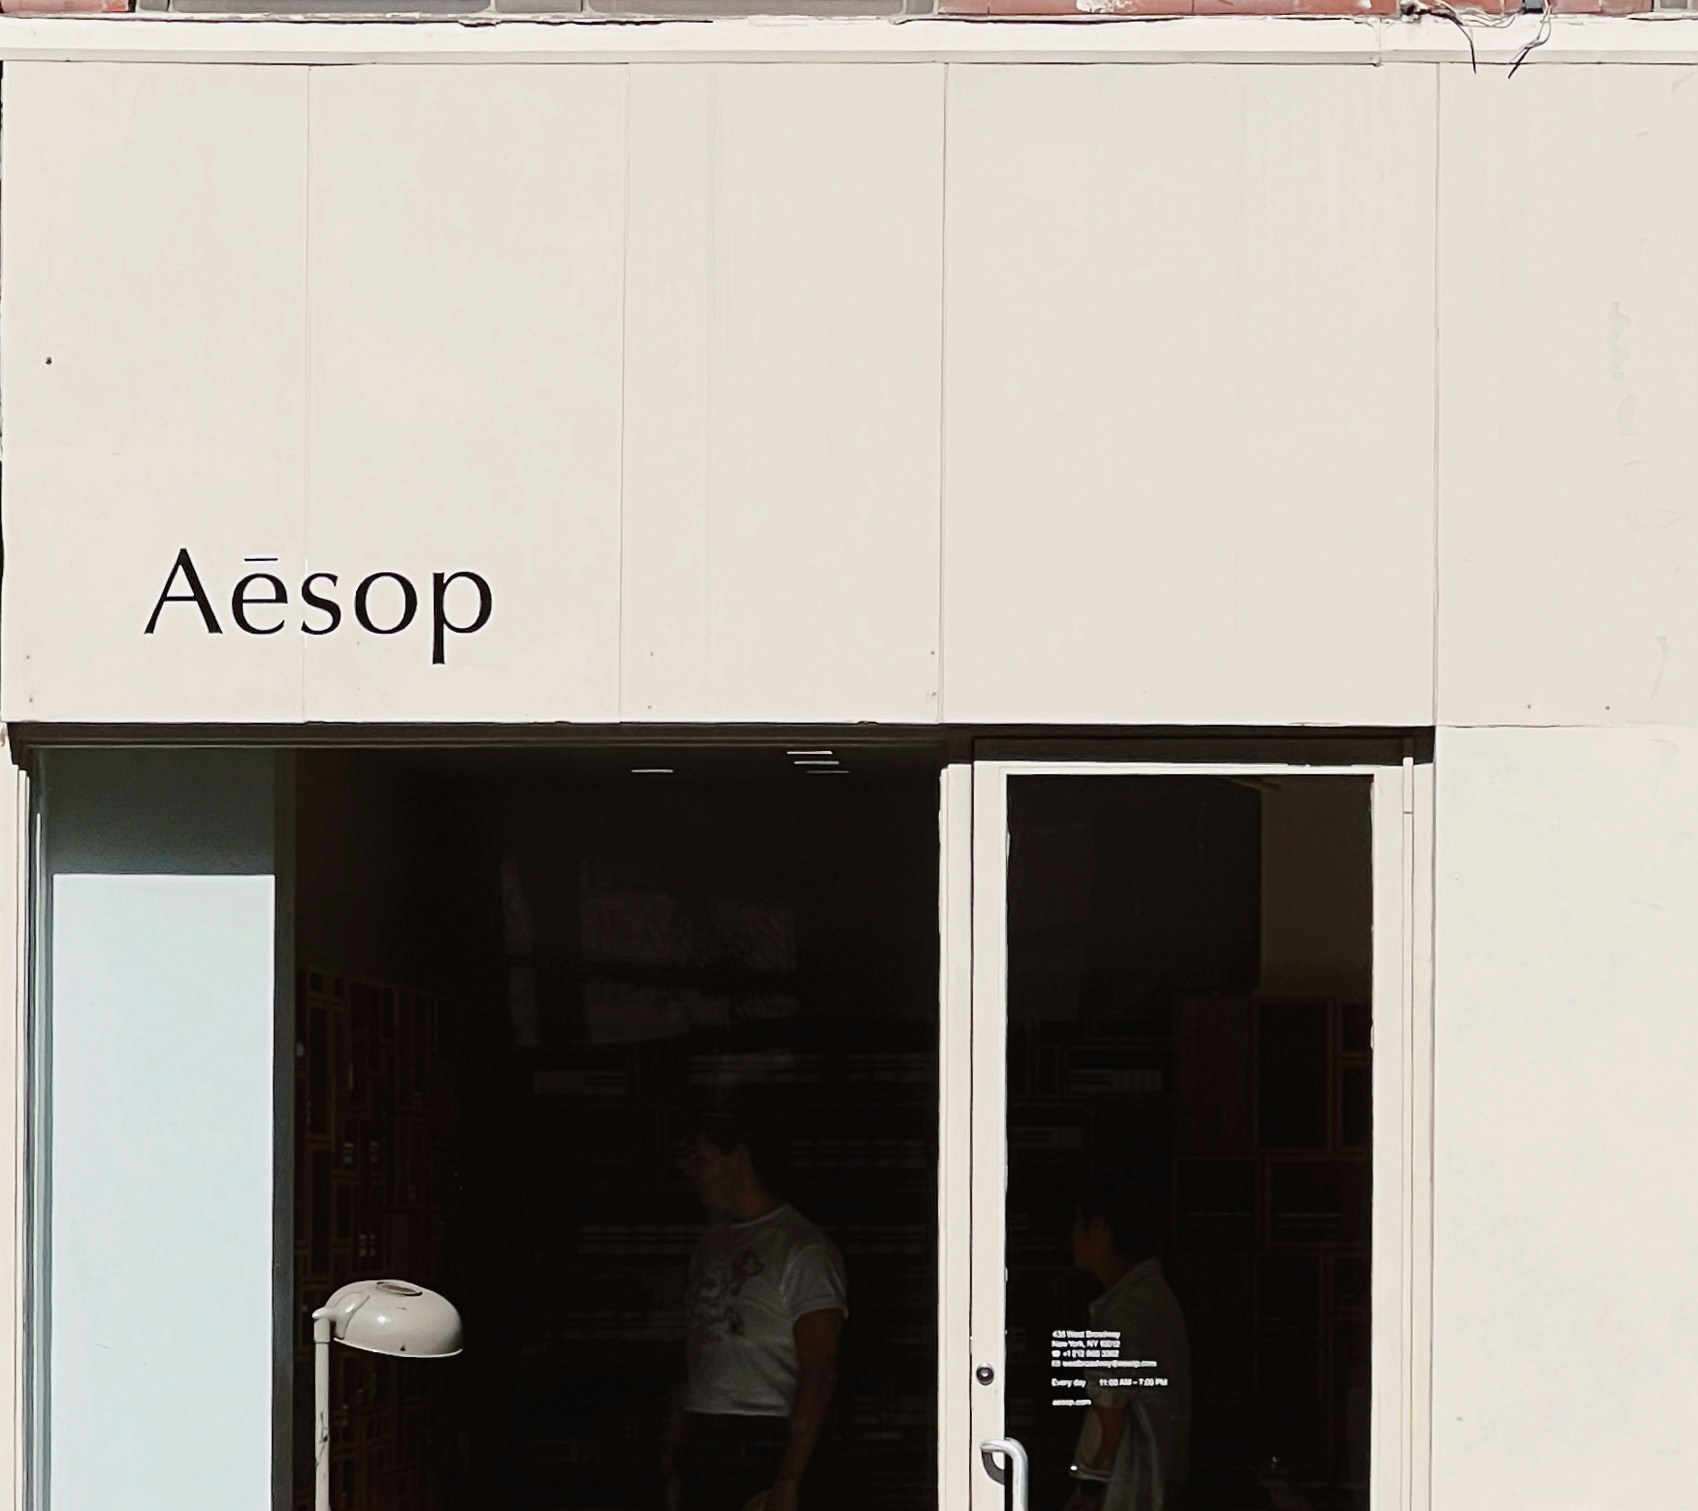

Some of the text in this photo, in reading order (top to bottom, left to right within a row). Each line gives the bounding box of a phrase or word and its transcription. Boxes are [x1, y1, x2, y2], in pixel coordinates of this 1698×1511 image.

[144, 548, 492, 665] Aēsop
[1051, 1340, 1068, 1348] New
[1086, 1340, 1098, 1348] NY
[1051, 1378, 1072, 1388] Every
[1073, 1378, 1086, 1388] day
[1119, 1378, 1132, 1386] AM
[1155, 1378, 1168, 1386] PM
